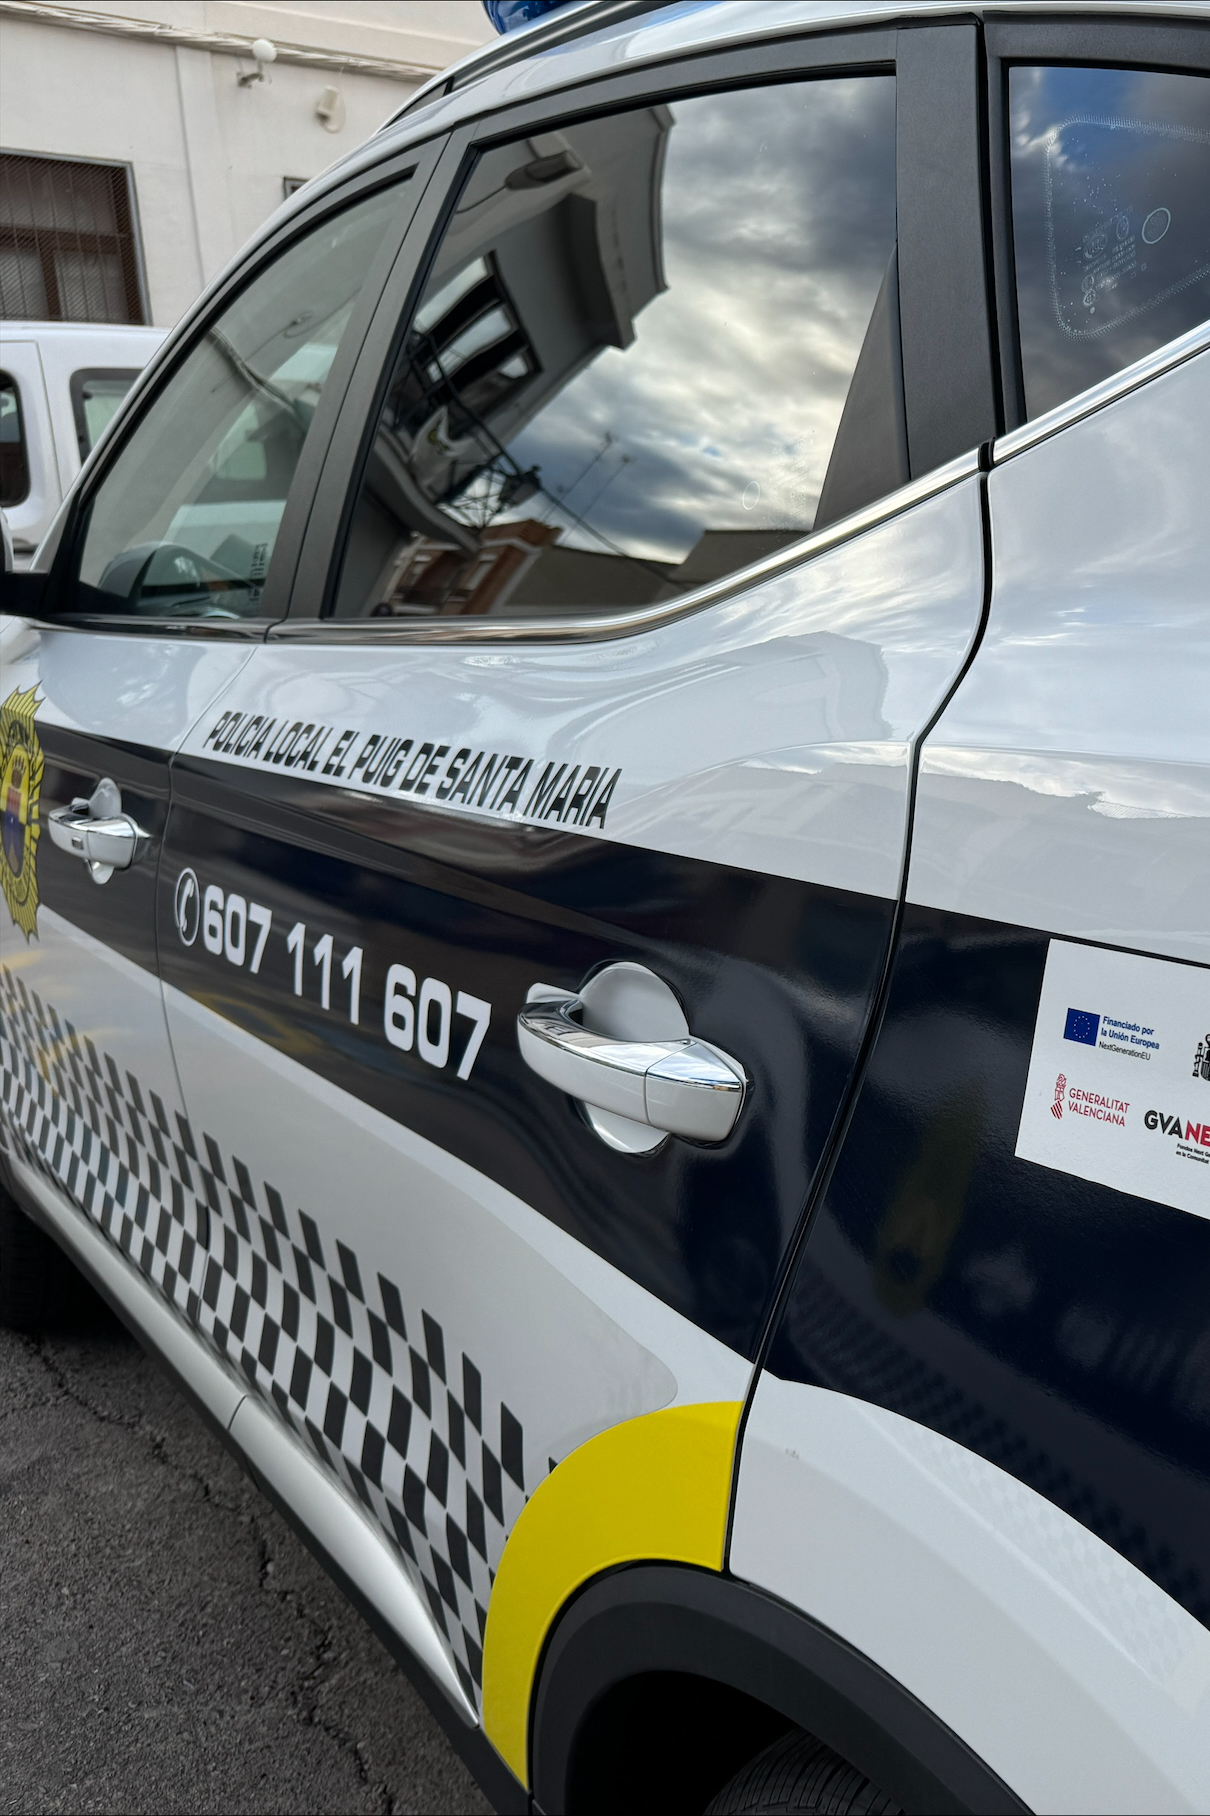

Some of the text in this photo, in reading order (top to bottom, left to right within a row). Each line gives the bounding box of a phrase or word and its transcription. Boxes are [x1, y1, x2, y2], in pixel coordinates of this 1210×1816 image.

[203, 710, 623, 829] POLICIA LOCAL EL PUIG DE SANTA MARIA
[202, 884, 492, 1081] 607 111 607
[1101, 1027, 1160, 1050] la Unión Europea
[1102, 1016, 1155, 1036] Financiado por
[1098, 1041, 1151, 1061] NextGenerationEU
[1069, 1087, 1131, 1114] GENERALITAT
[1068, 1101, 1126, 1127] VALENCIANA
